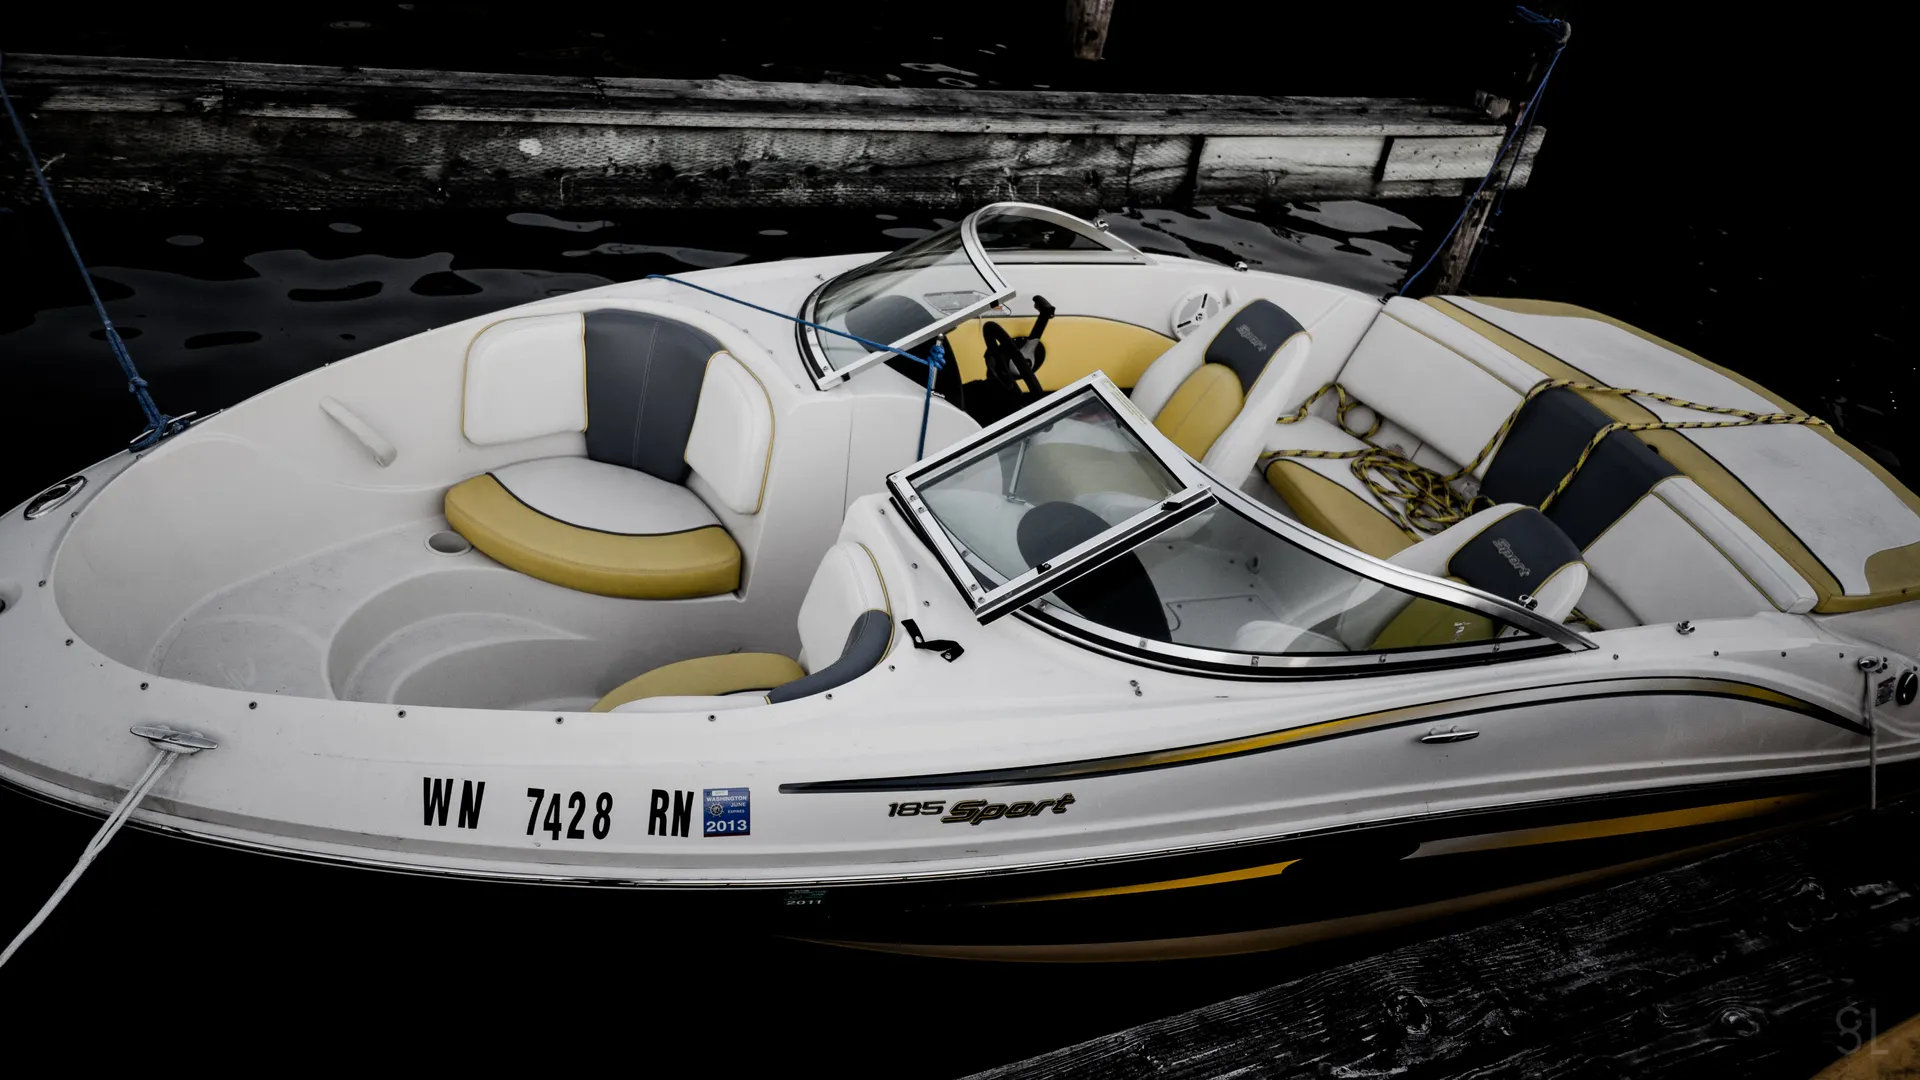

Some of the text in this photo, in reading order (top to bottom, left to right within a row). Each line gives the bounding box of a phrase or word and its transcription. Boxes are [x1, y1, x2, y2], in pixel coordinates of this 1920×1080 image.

[1235, 323, 1267, 352] Sport
[1492, 537, 1531, 578] Sport
[423, 777, 695, 841] WN 7428 RN
[706, 819, 748, 832] 2013
[888, 792, 1076, 826] 185 Sport
